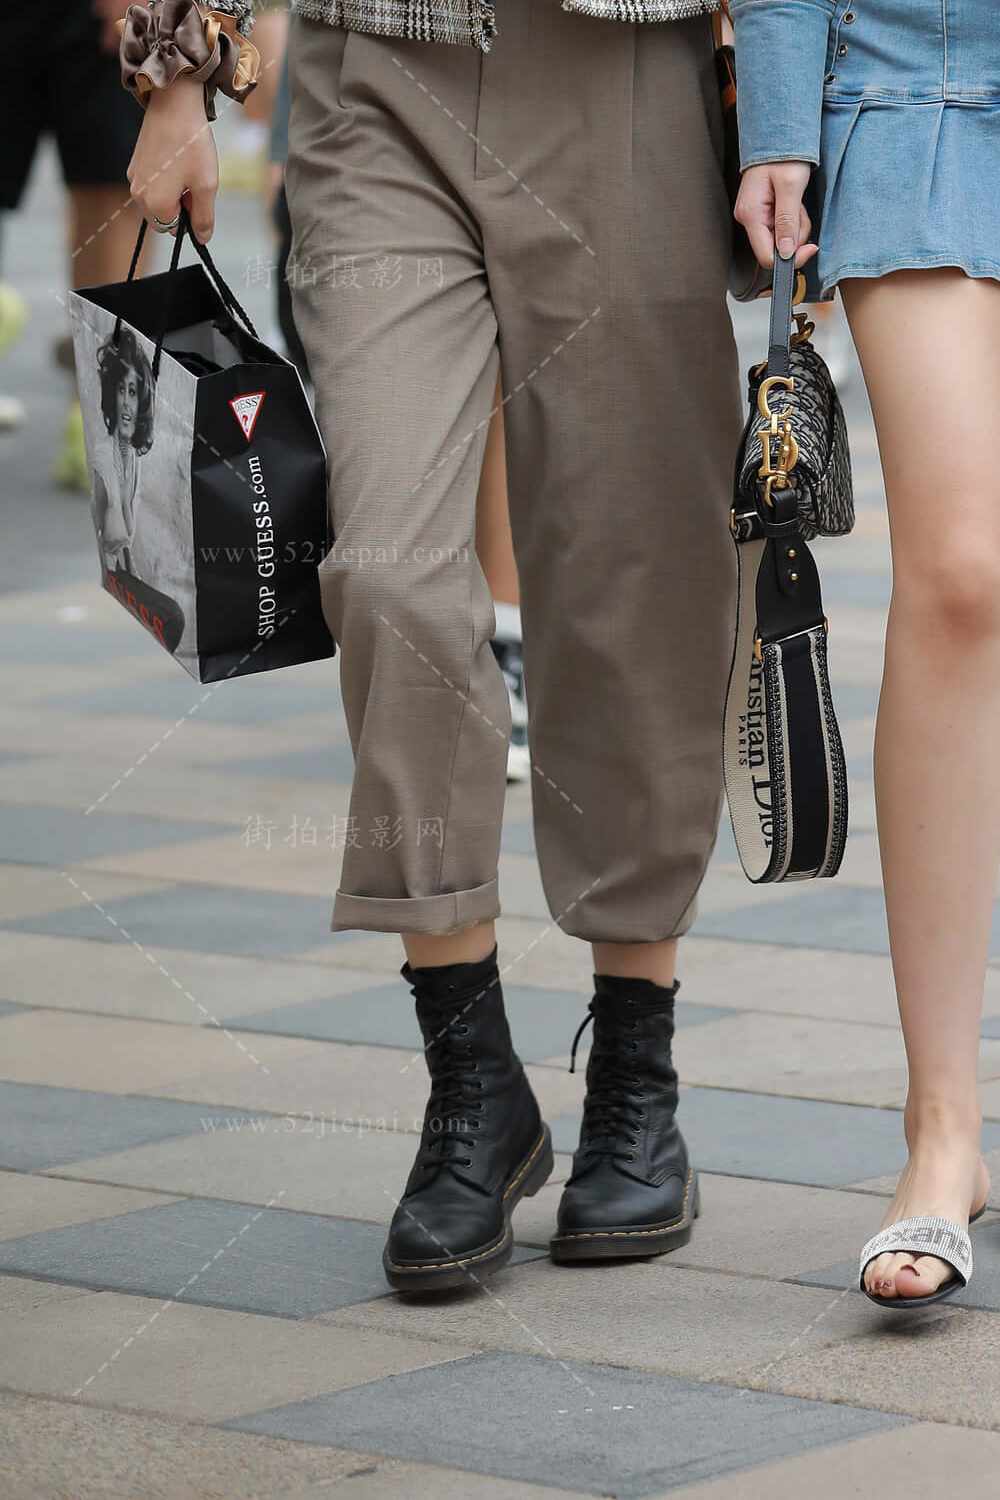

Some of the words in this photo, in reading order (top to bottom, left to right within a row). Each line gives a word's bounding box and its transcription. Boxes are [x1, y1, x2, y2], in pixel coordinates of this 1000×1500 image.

[248, 455, 275, 578] GUESS.com
[258, 586, 277, 636] SHOP
[737, 714, 748, 767] PARIS
